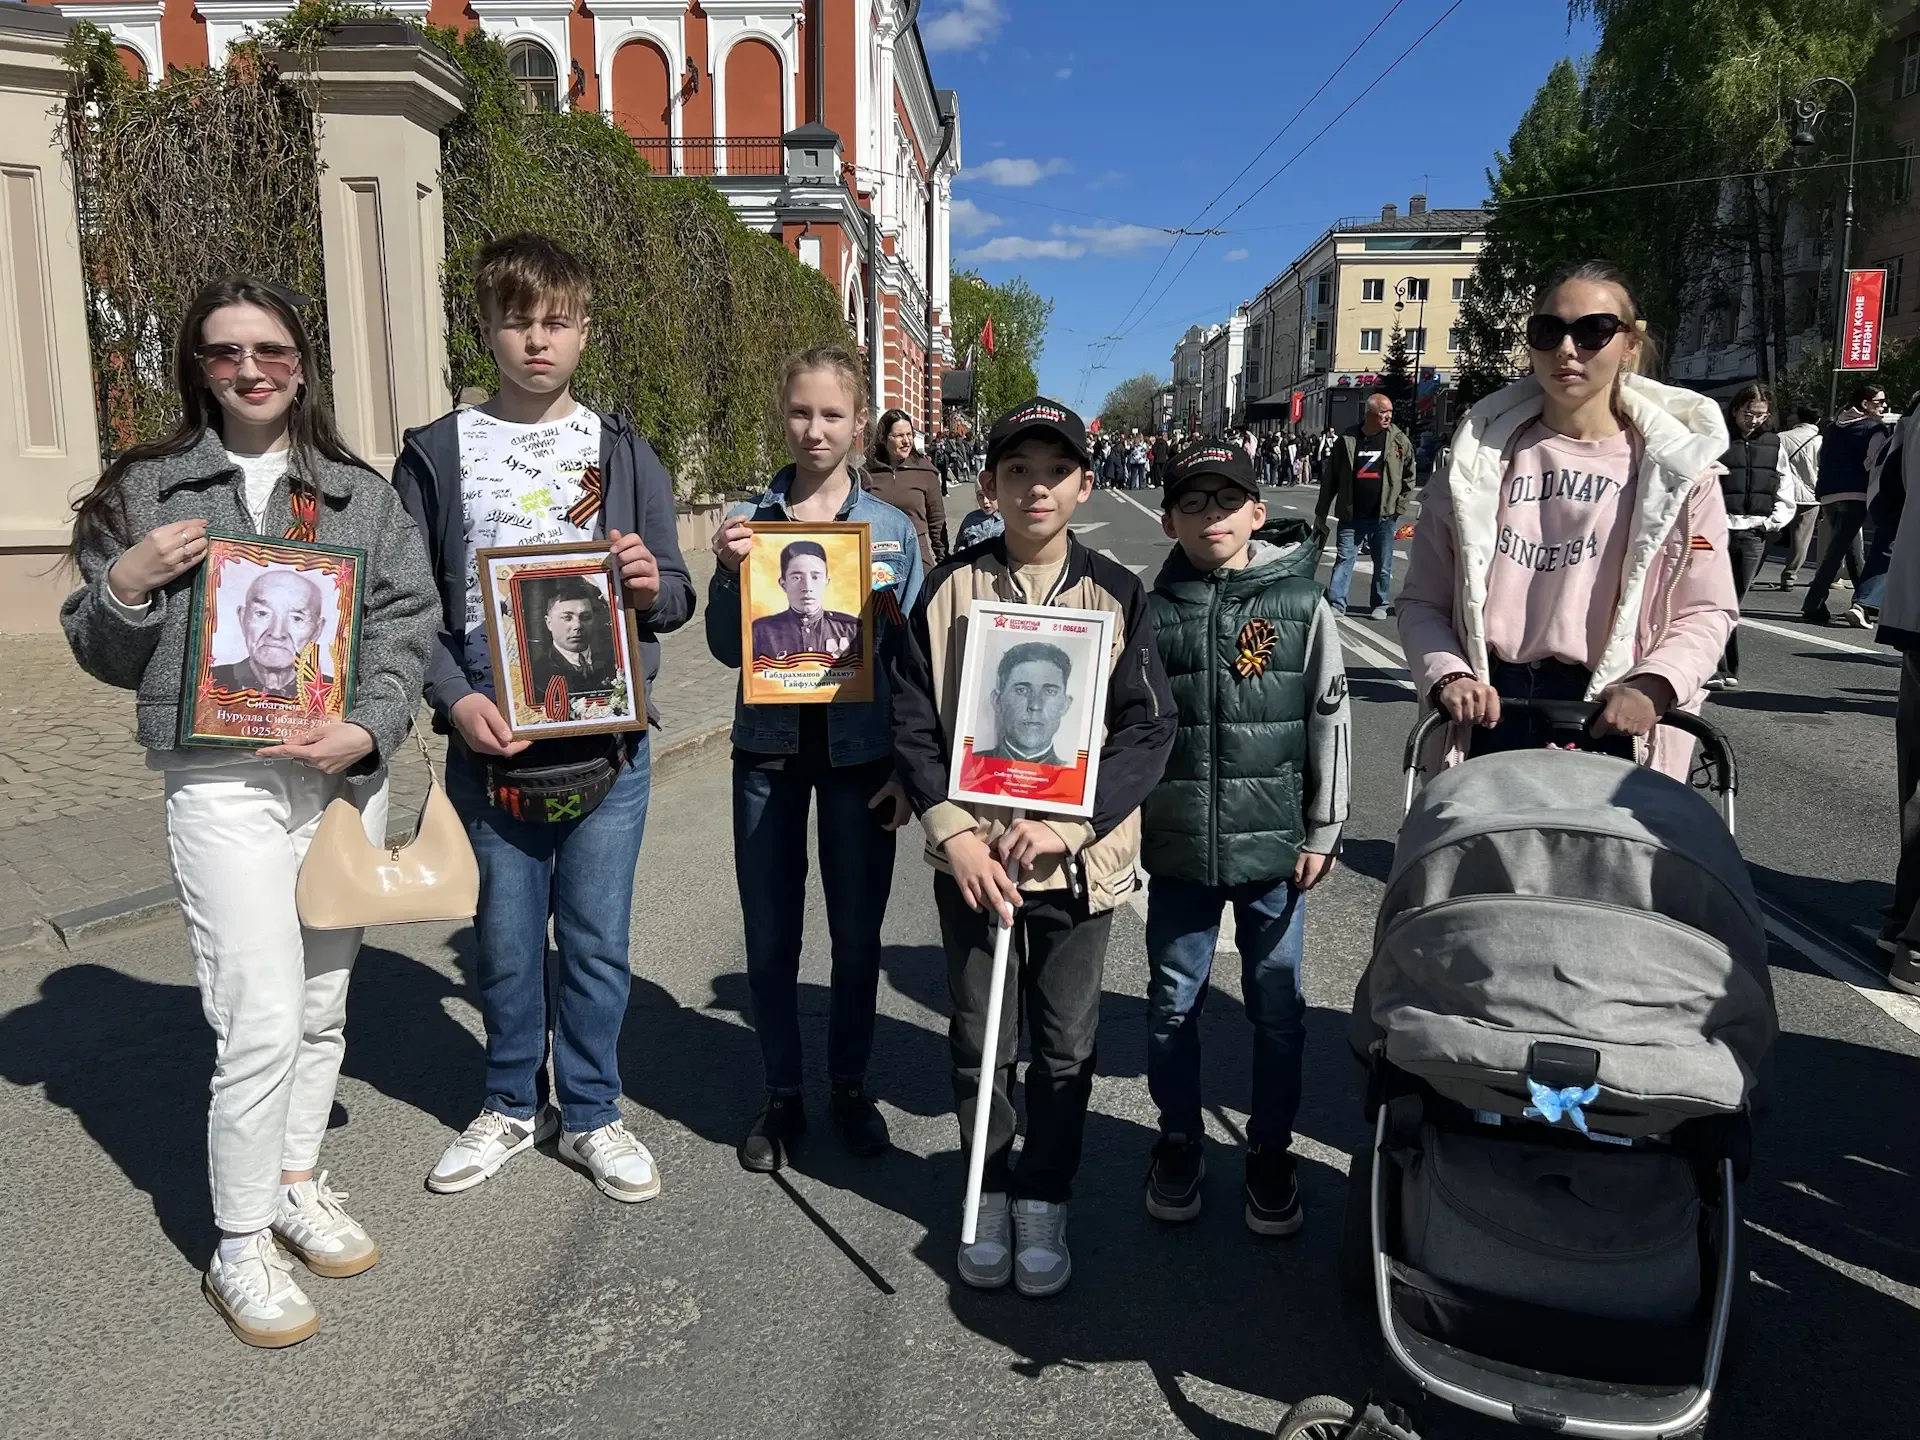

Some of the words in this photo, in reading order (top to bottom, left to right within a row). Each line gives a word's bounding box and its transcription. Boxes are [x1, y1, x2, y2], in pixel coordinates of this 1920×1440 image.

[1853, 295, 1865, 327] КӨНЕ
[510, 431, 540, 446] WORLD
[541, 426, 561, 438] THE
[522, 437, 556, 453] CHANGE
[1357, 450, 1382, 478] Z
[1508, 469, 1555, 507] OLD
[548, 526, 564, 539] THE
[1500, 525, 1560, 572] SINCE
[1009, 618, 1041, 627] БЕССМЕРТНЫЙ
[1062, 624, 1088, 633] ПОБЕДА!
[763, 670, 821, 680] Габдрахманов
[823, 669, 855, 679] Махмут
[783, 679, 836, 689] Гайфуллович
[246, 697, 302, 711] Сибагатов
[216, 709, 263, 724] Нурулла
[265, 713, 308, 726] Сибагат
